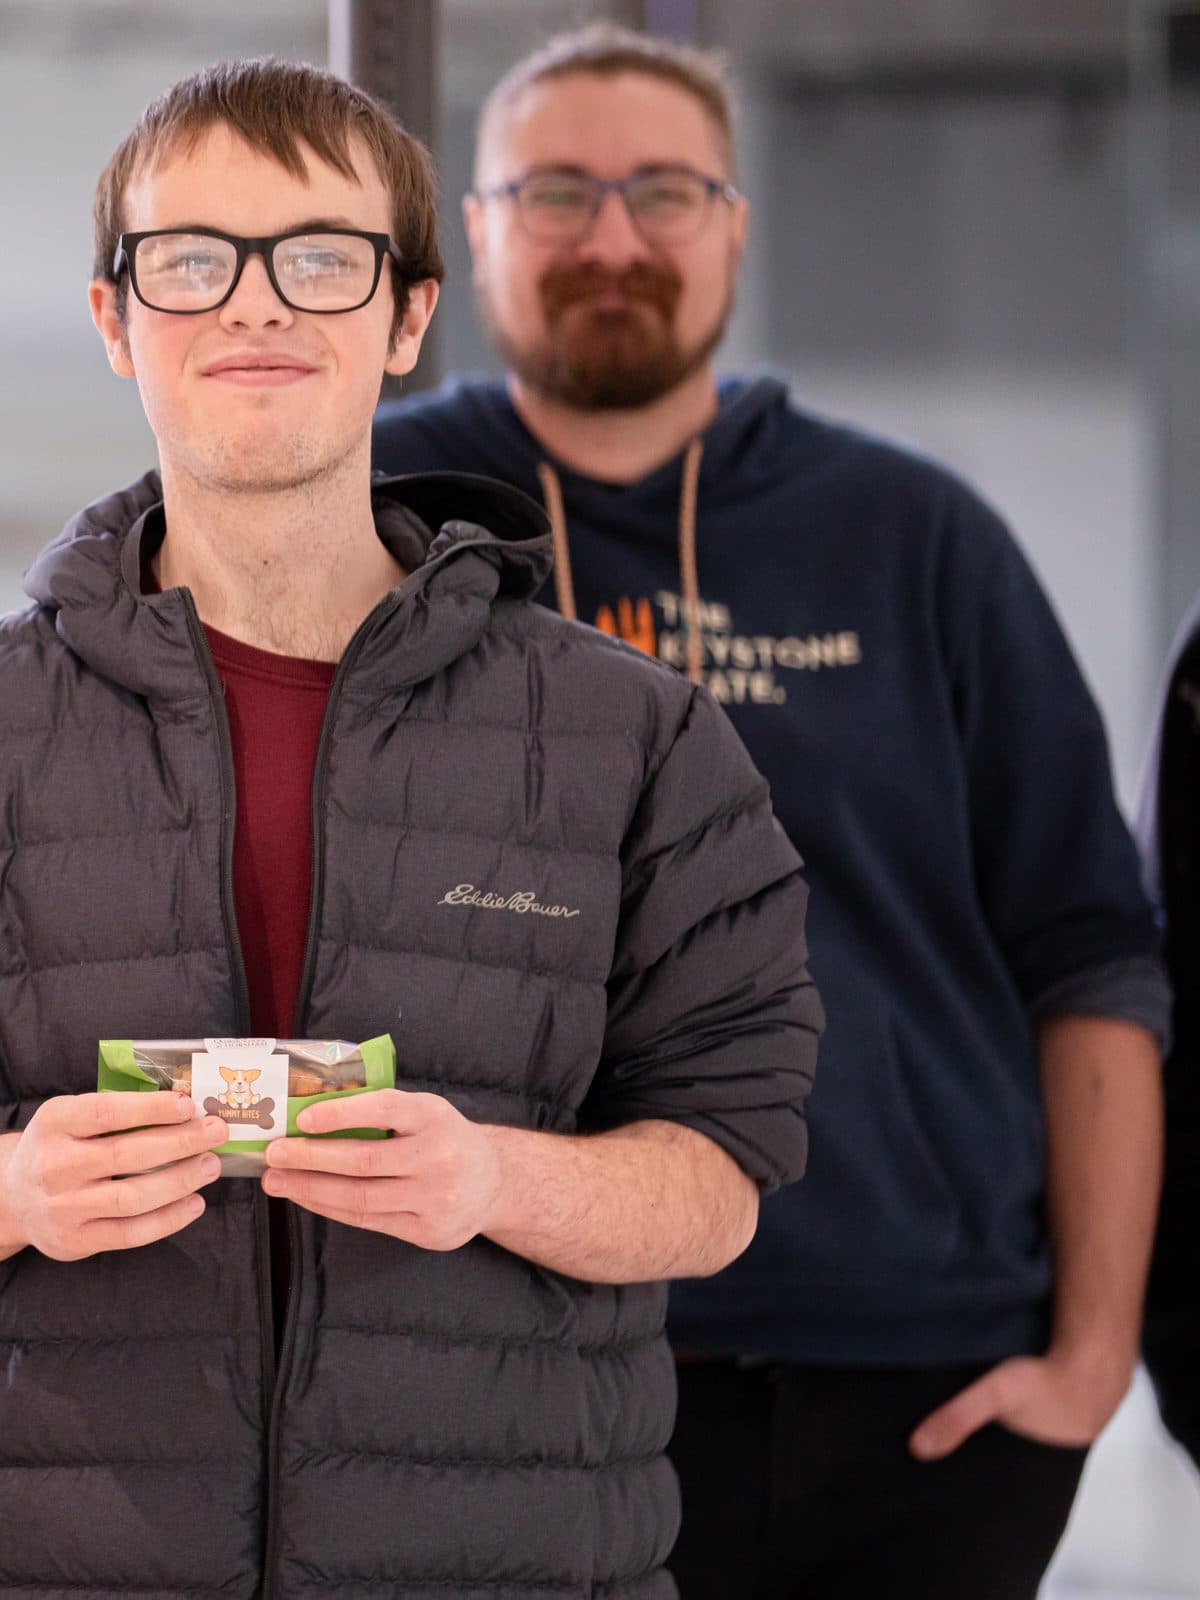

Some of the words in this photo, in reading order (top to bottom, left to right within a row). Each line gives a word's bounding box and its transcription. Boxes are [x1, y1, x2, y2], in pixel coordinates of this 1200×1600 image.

[660, 631, 860, 671] KYSTONE
[437, 884, 508, 909] Eddie
[509, 892, 580, 918] Bauer
[218, 1109, 240, 1118] YUMMY
